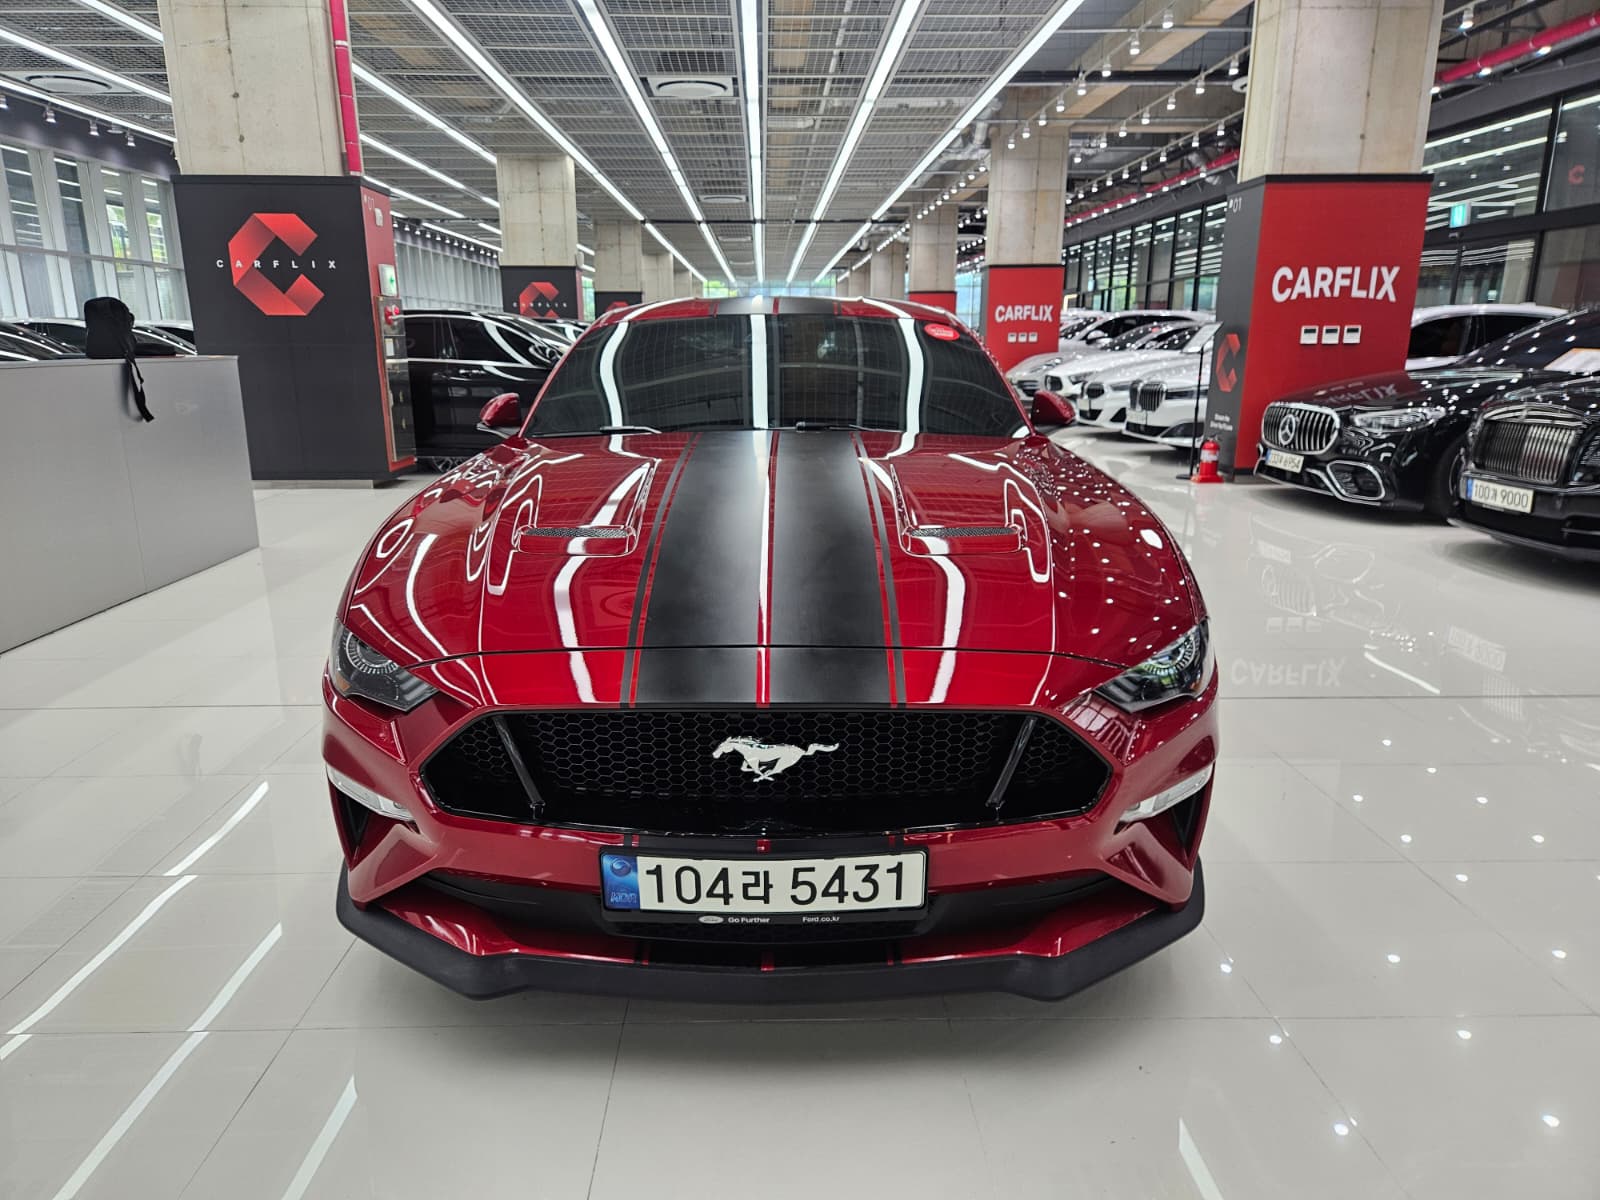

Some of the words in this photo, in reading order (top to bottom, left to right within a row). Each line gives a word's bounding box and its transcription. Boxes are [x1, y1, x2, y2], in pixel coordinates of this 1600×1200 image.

[216, 259, 336, 269] CARFLIX
[1272, 266, 1400, 302] CARFLIX
[995, 304, 1053, 323] CARFLIX
[1500, 489, 1529, 508] 9000
[646, 864, 774, 905] 104라
[790, 861, 903, 906] 5431
